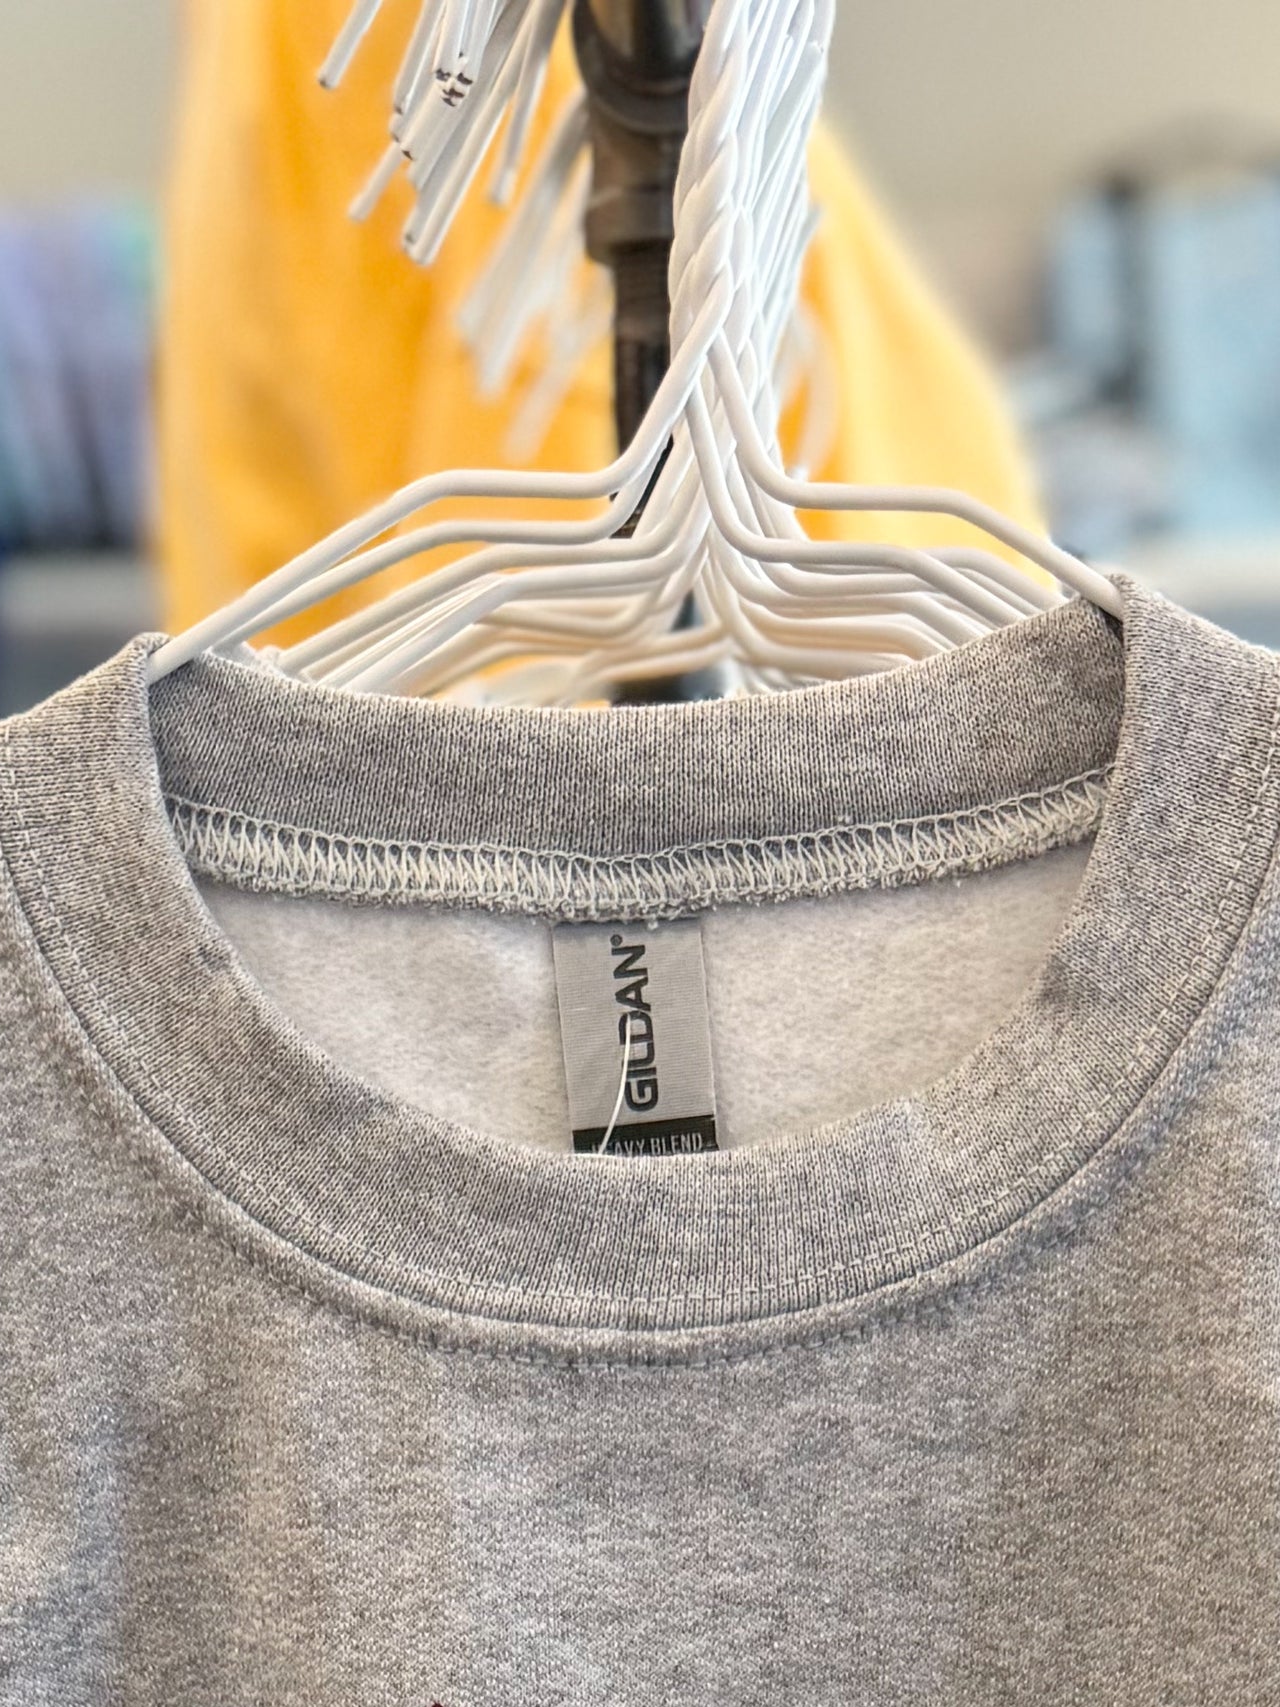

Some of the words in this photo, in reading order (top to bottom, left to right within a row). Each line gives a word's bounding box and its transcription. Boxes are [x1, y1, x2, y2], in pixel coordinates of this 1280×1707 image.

[611, 941, 660, 1113] GILDAN
[592, 1138, 646, 1157] AVY
[650, 1132, 703, 1156] BLEND
